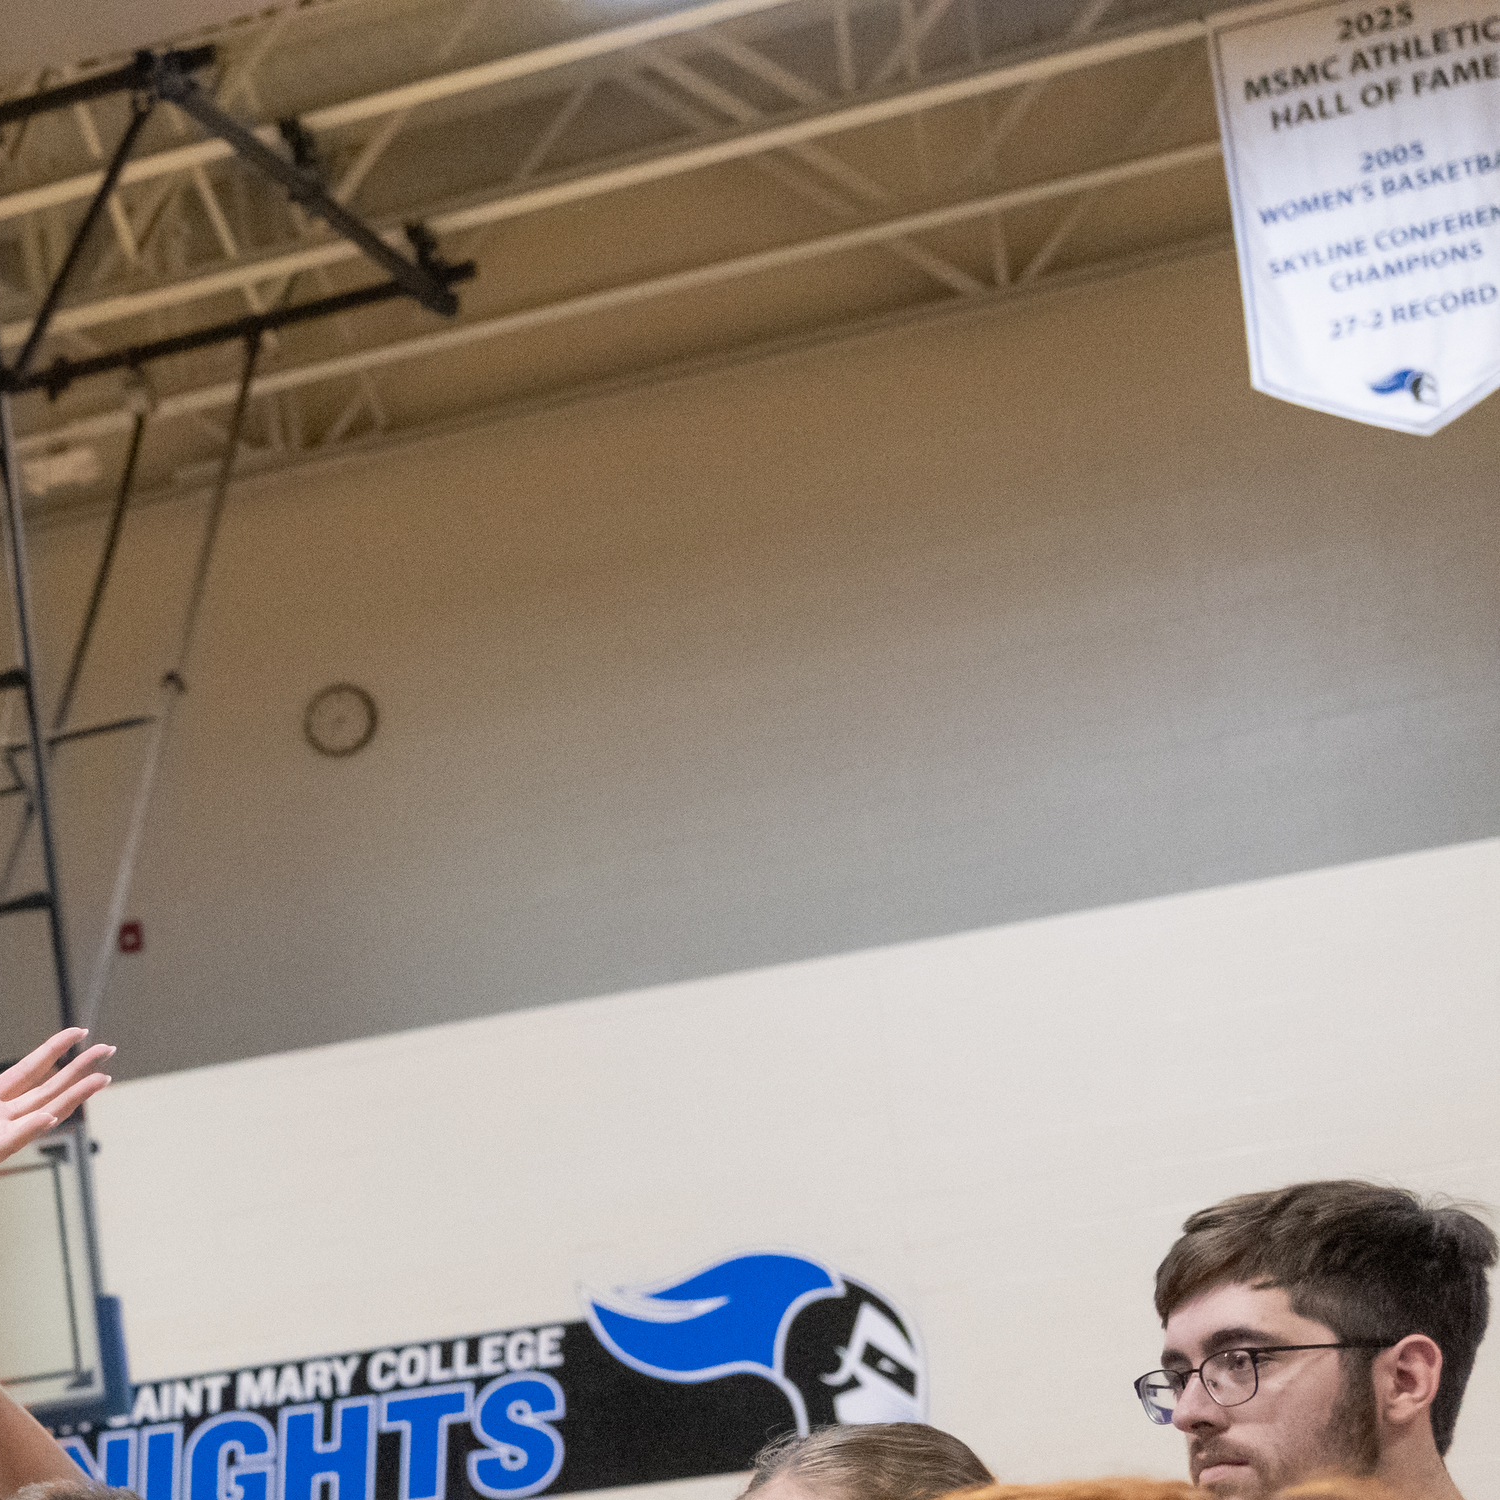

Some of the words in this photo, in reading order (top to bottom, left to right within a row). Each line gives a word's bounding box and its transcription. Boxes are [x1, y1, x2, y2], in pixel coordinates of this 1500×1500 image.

[1336, 2, 1414, 42] 2025
[1244, 54, 1341, 102] MSMC
[1270, 91, 1352, 131] HALL
[1359, 78, 1402, 108] OF
[1411, 52, 1499, 97] FAME
[1258, 180, 1374, 225] WOMEN'S
[1269, 238, 1367, 279] SKYLINE
[1329, 239, 1483, 292] CHAMPIONS
[1391, 284, 1498, 323] RECORD
[108, 1376, 233, 1428] AINT
[236, 1355, 361, 1408] MARY
[368, 1327, 565, 1388] COLLEGE
